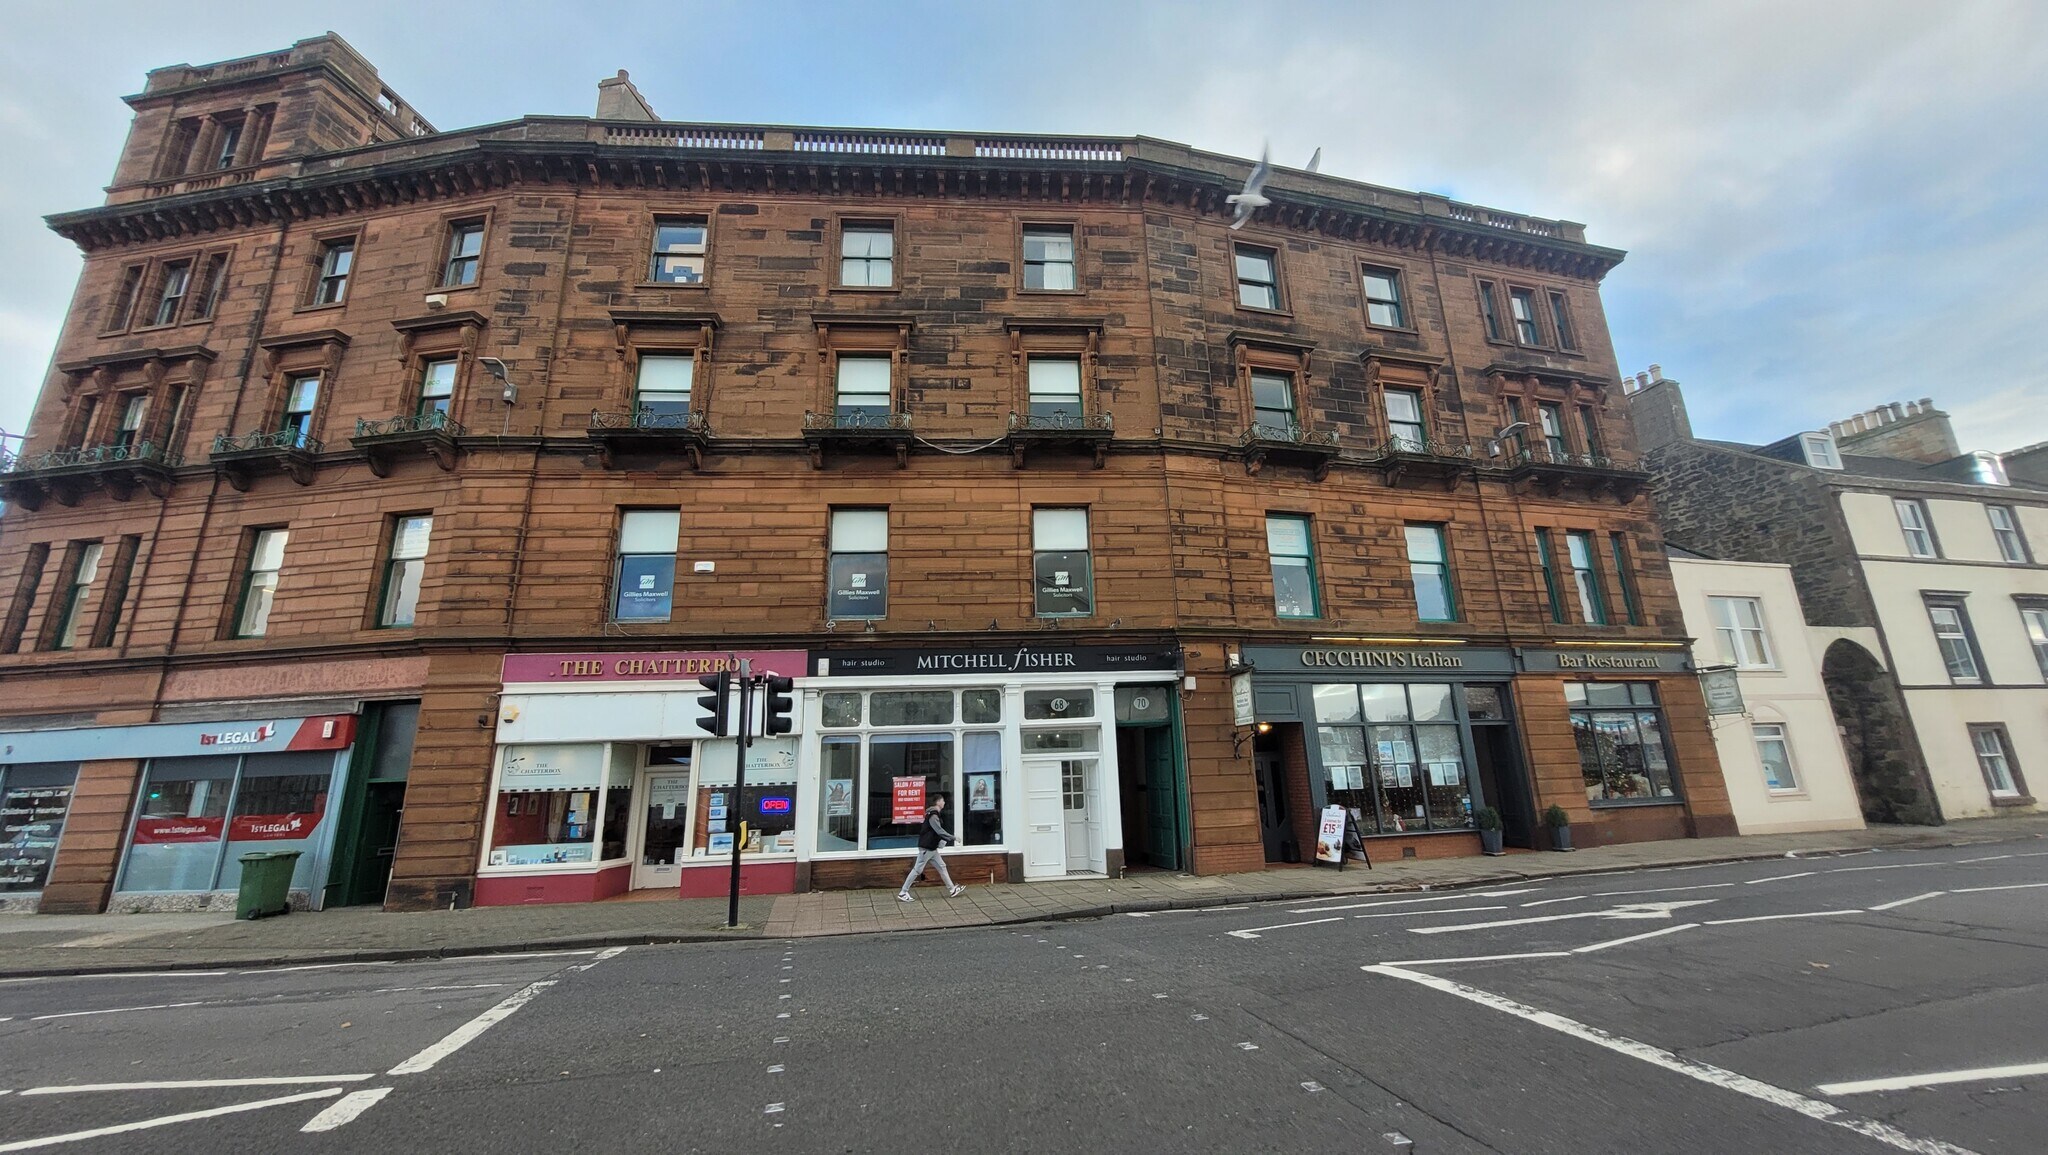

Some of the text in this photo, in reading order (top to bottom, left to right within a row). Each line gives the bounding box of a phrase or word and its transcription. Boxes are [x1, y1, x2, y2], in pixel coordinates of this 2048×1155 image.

[842, 659, 886, 667] hair studio
[917, 654, 1007, 669] MITCHELL
[1301, 650, 1463, 668] CECCHINI'S Italian
[1558, 653, 1661, 668] Bar Restaurant
[560, 660, 604, 676] THE
[1054, 699, 1064, 710] 68
[1137, 698, 1146, 708] 70
[763, 800, 788, 810] OPEN
